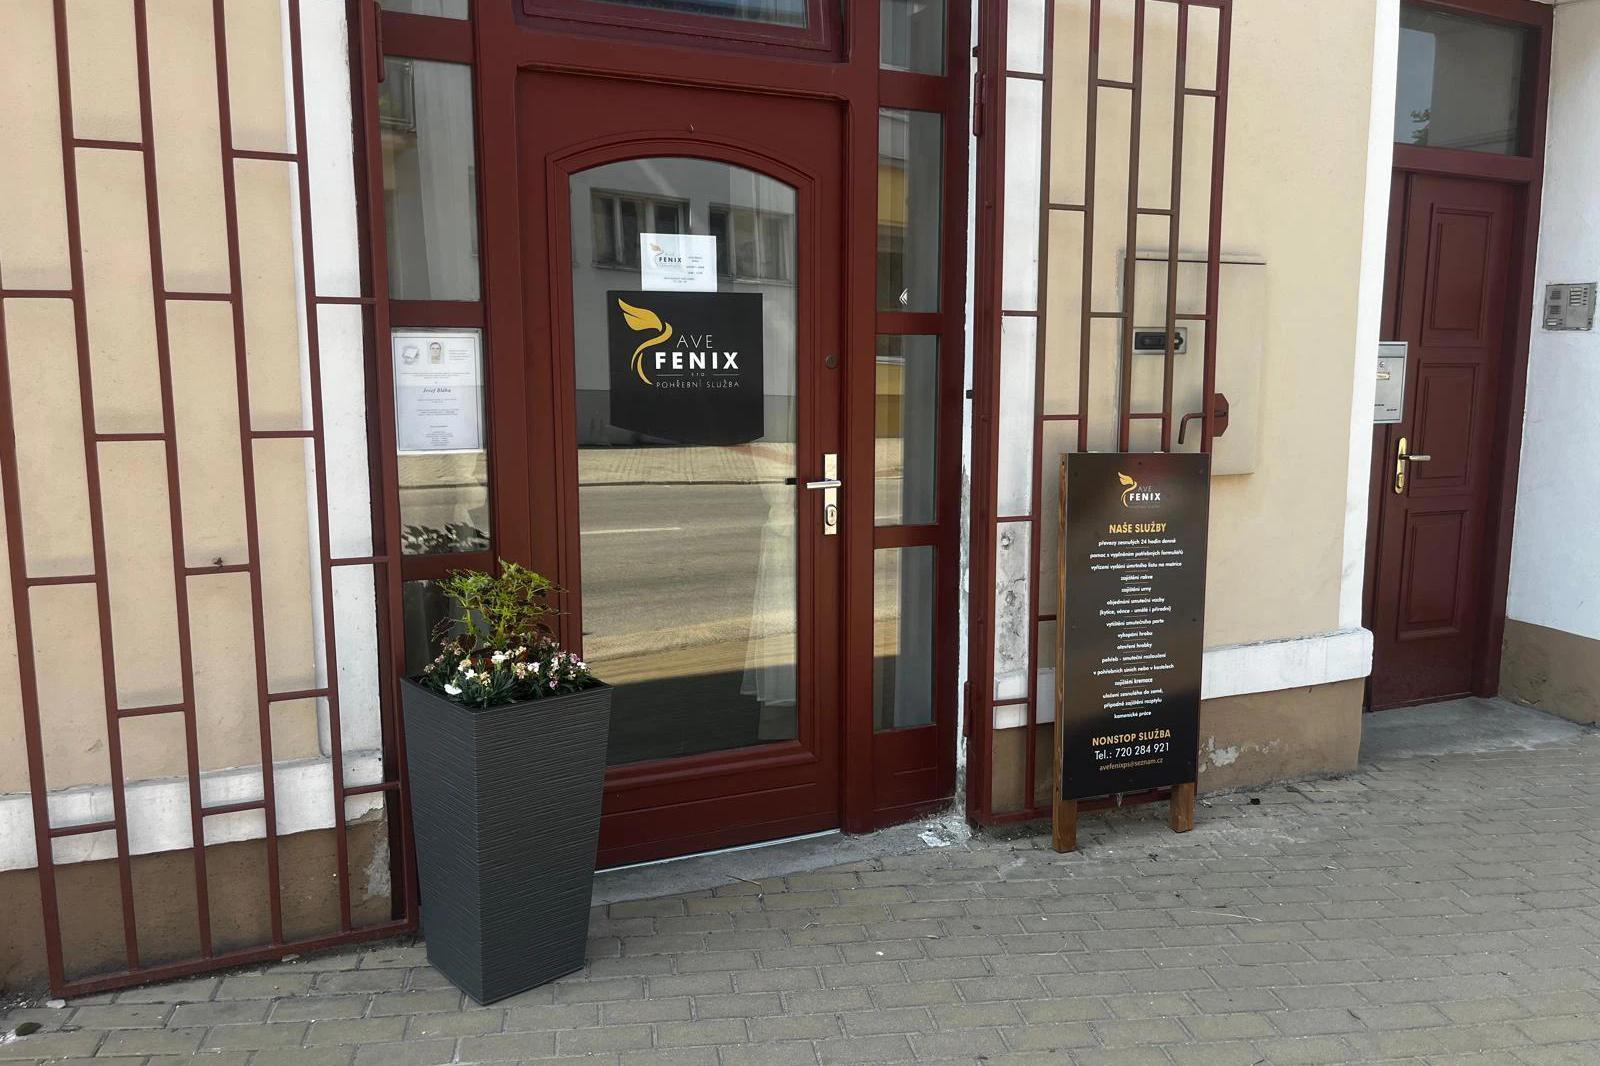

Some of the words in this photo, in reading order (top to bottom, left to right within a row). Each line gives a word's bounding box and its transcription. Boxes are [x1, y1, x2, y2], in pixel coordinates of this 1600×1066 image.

[676, 335, 713, 348] AVE
[655, 352, 738, 370] FENIX
[656, 379, 702, 388] POHŘEBNÍ
[706, 378, 739, 388] SLUŽBA
[1129, 493, 1160, 501] FENIX
[1109, 522, 1132, 533] NAŠE
[1135, 521, 1166, 533] SLUŽBY
[1092, 733, 1137, 746] NONSTOP
[1138, 728, 1171, 741] SLUŽBA
[1094, 750, 1112, 760] Tel.:
[1115, 747, 1132, 758] 720
[1134, 745, 1151, 756] 284
[1154, 742, 1169, 753] 921
[1100, 758, 1163, 771] avefenixps@seznam.cz
